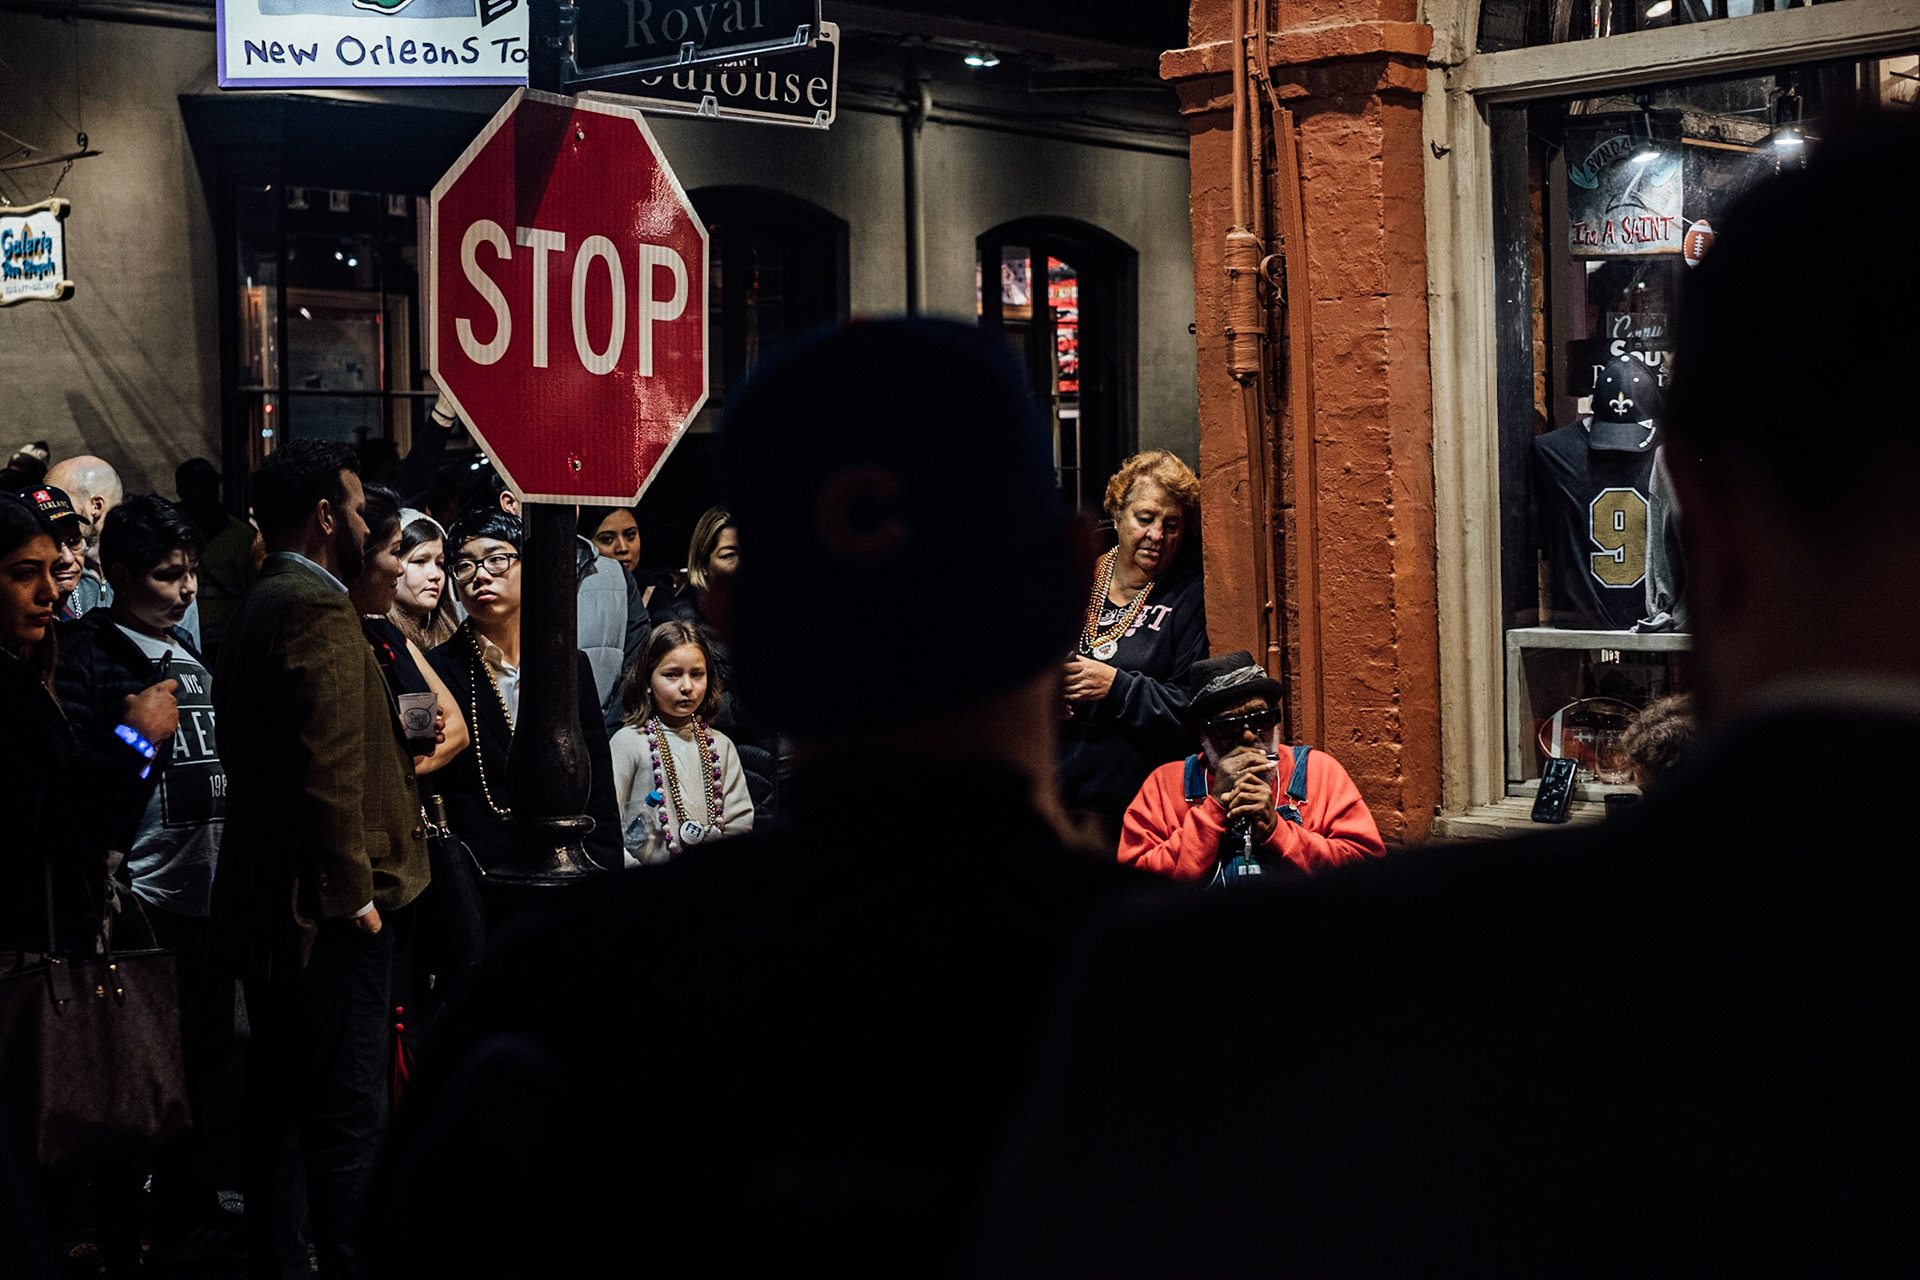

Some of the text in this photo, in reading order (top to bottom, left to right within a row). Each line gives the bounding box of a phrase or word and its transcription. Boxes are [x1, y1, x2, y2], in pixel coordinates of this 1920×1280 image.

[623, 0, 766, 50] Royal
[244, 39, 318, 66] New
[335, 35, 480, 66] Orleans
[1602, 219, 1617, 245] A
[1621, 215, 1675, 245] SAINT
[455, 218, 689, 378] STOP
[1589, 486, 1652, 588] 9
[179, 673, 204, 695] NYC
